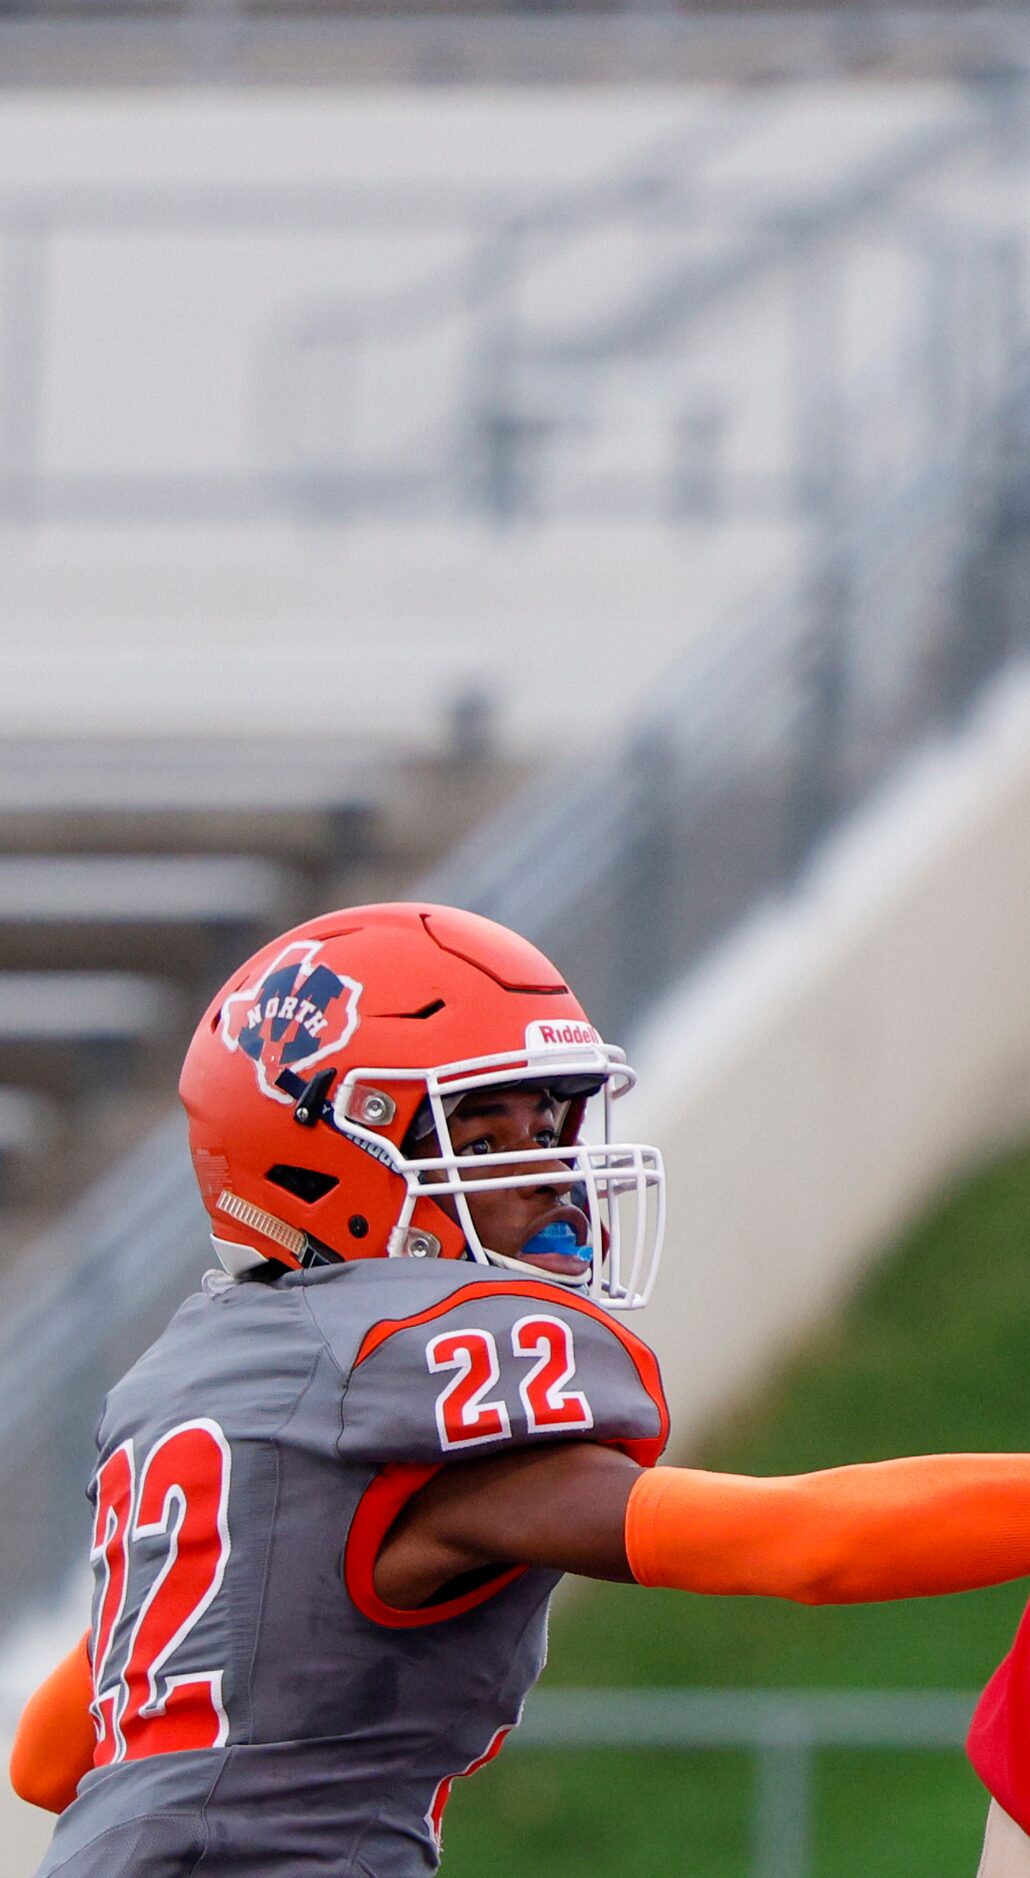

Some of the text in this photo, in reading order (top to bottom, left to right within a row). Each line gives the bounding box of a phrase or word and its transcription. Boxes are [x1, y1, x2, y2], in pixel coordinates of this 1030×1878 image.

[246, 995, 329, 1039] NORTH
[538, 1024, 600, 1045] Riddell
[424, 1313, 595, 1452] 22
[89, 1416, 233, 1767] 22
